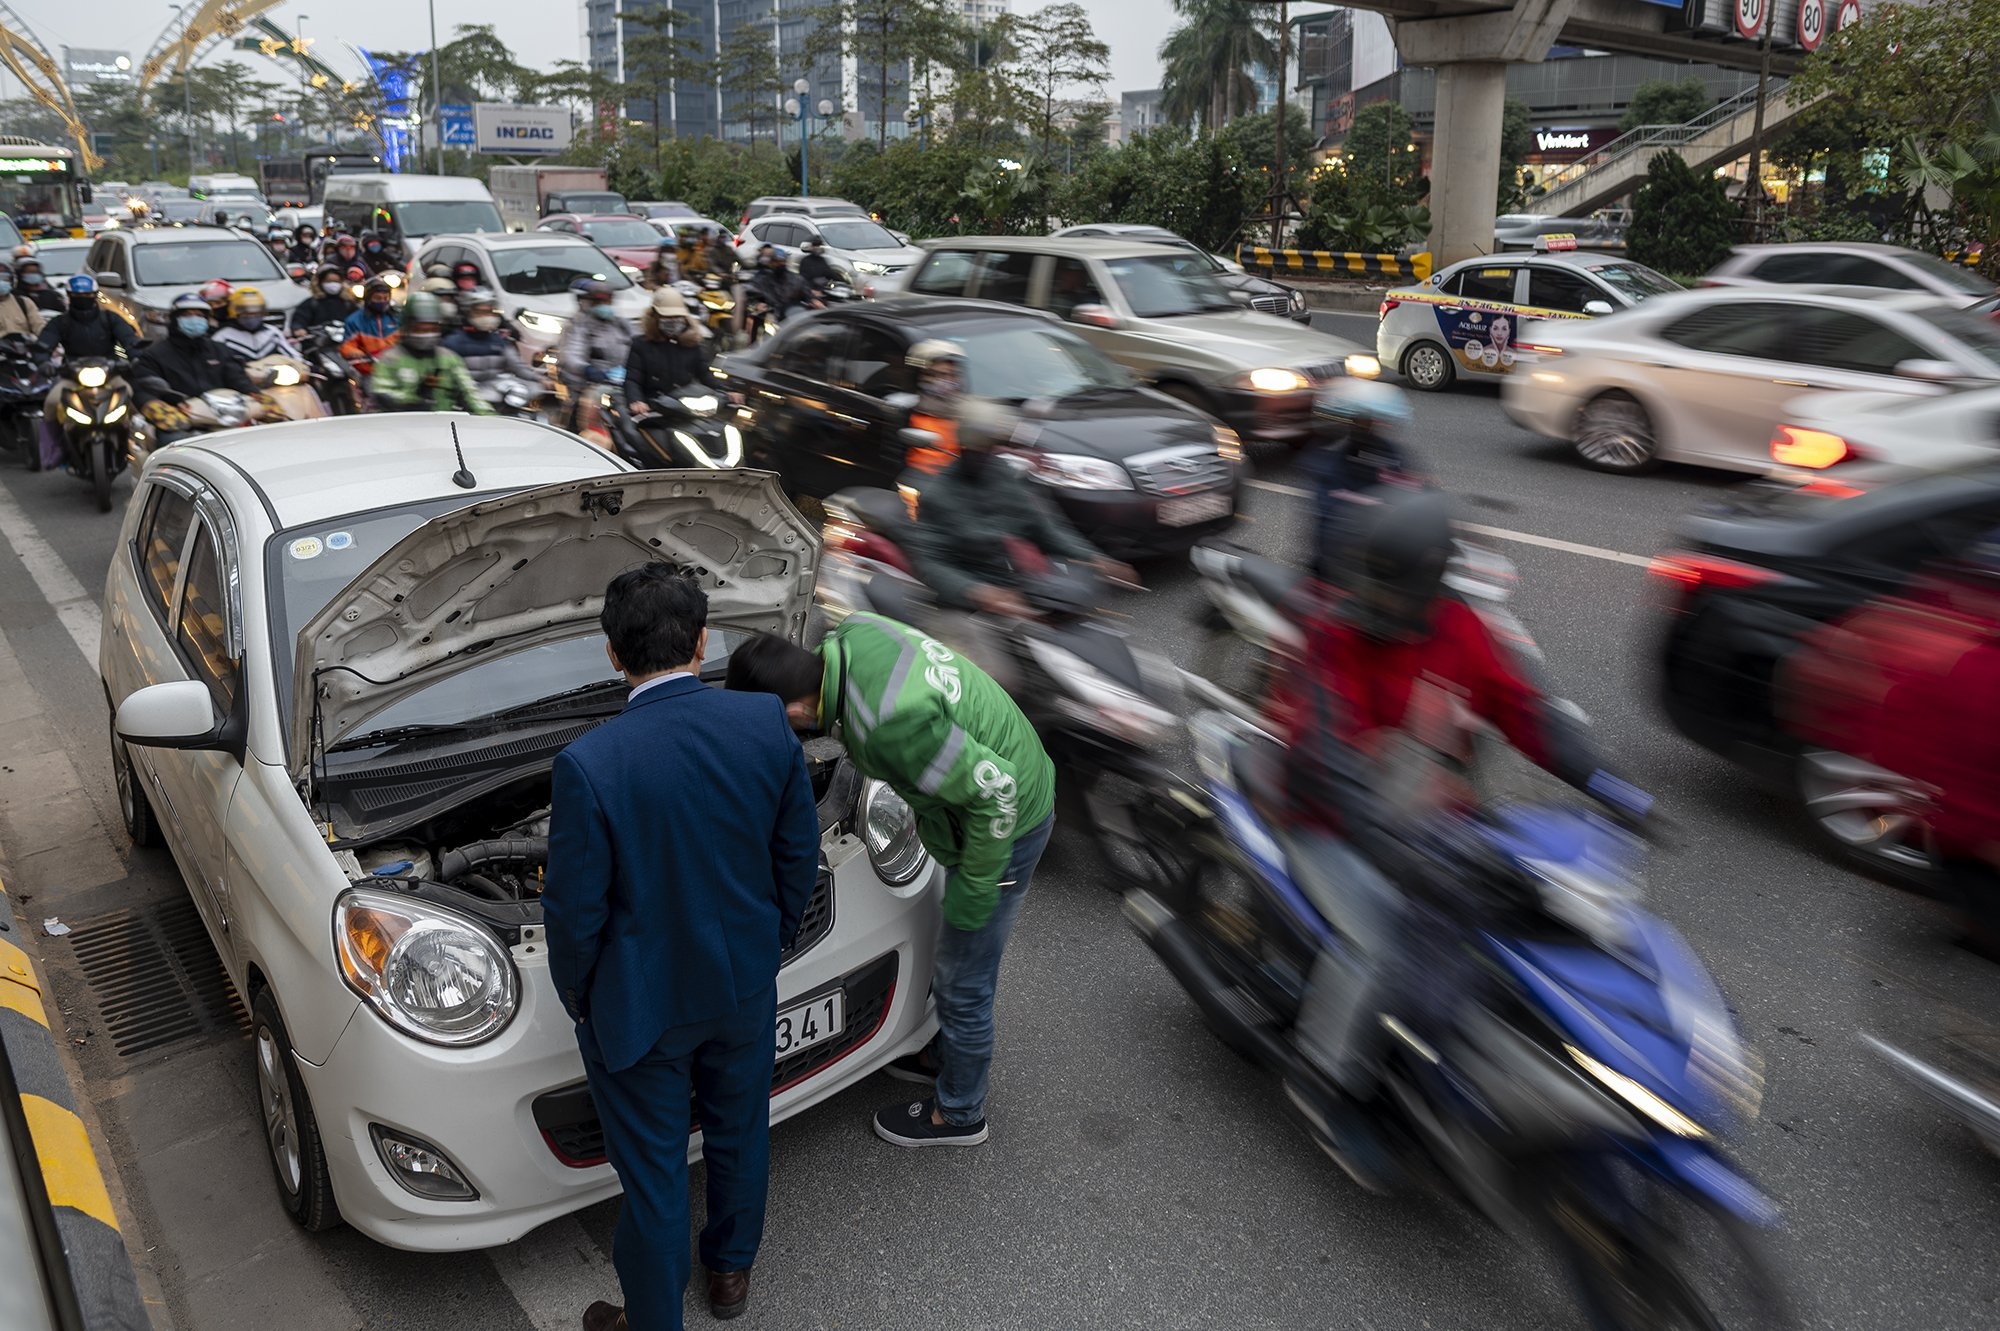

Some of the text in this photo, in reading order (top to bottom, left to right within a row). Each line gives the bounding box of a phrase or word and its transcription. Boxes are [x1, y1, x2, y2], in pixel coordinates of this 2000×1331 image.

[1742, 0, 1759, 19] 90
[1804, 5, 1820, 33] 80
[497, 126, 553, 139] INOAC
[1537, 133, 1589, 151] VinMart
[1458, 321, 1487, 331] AQUALUZ
